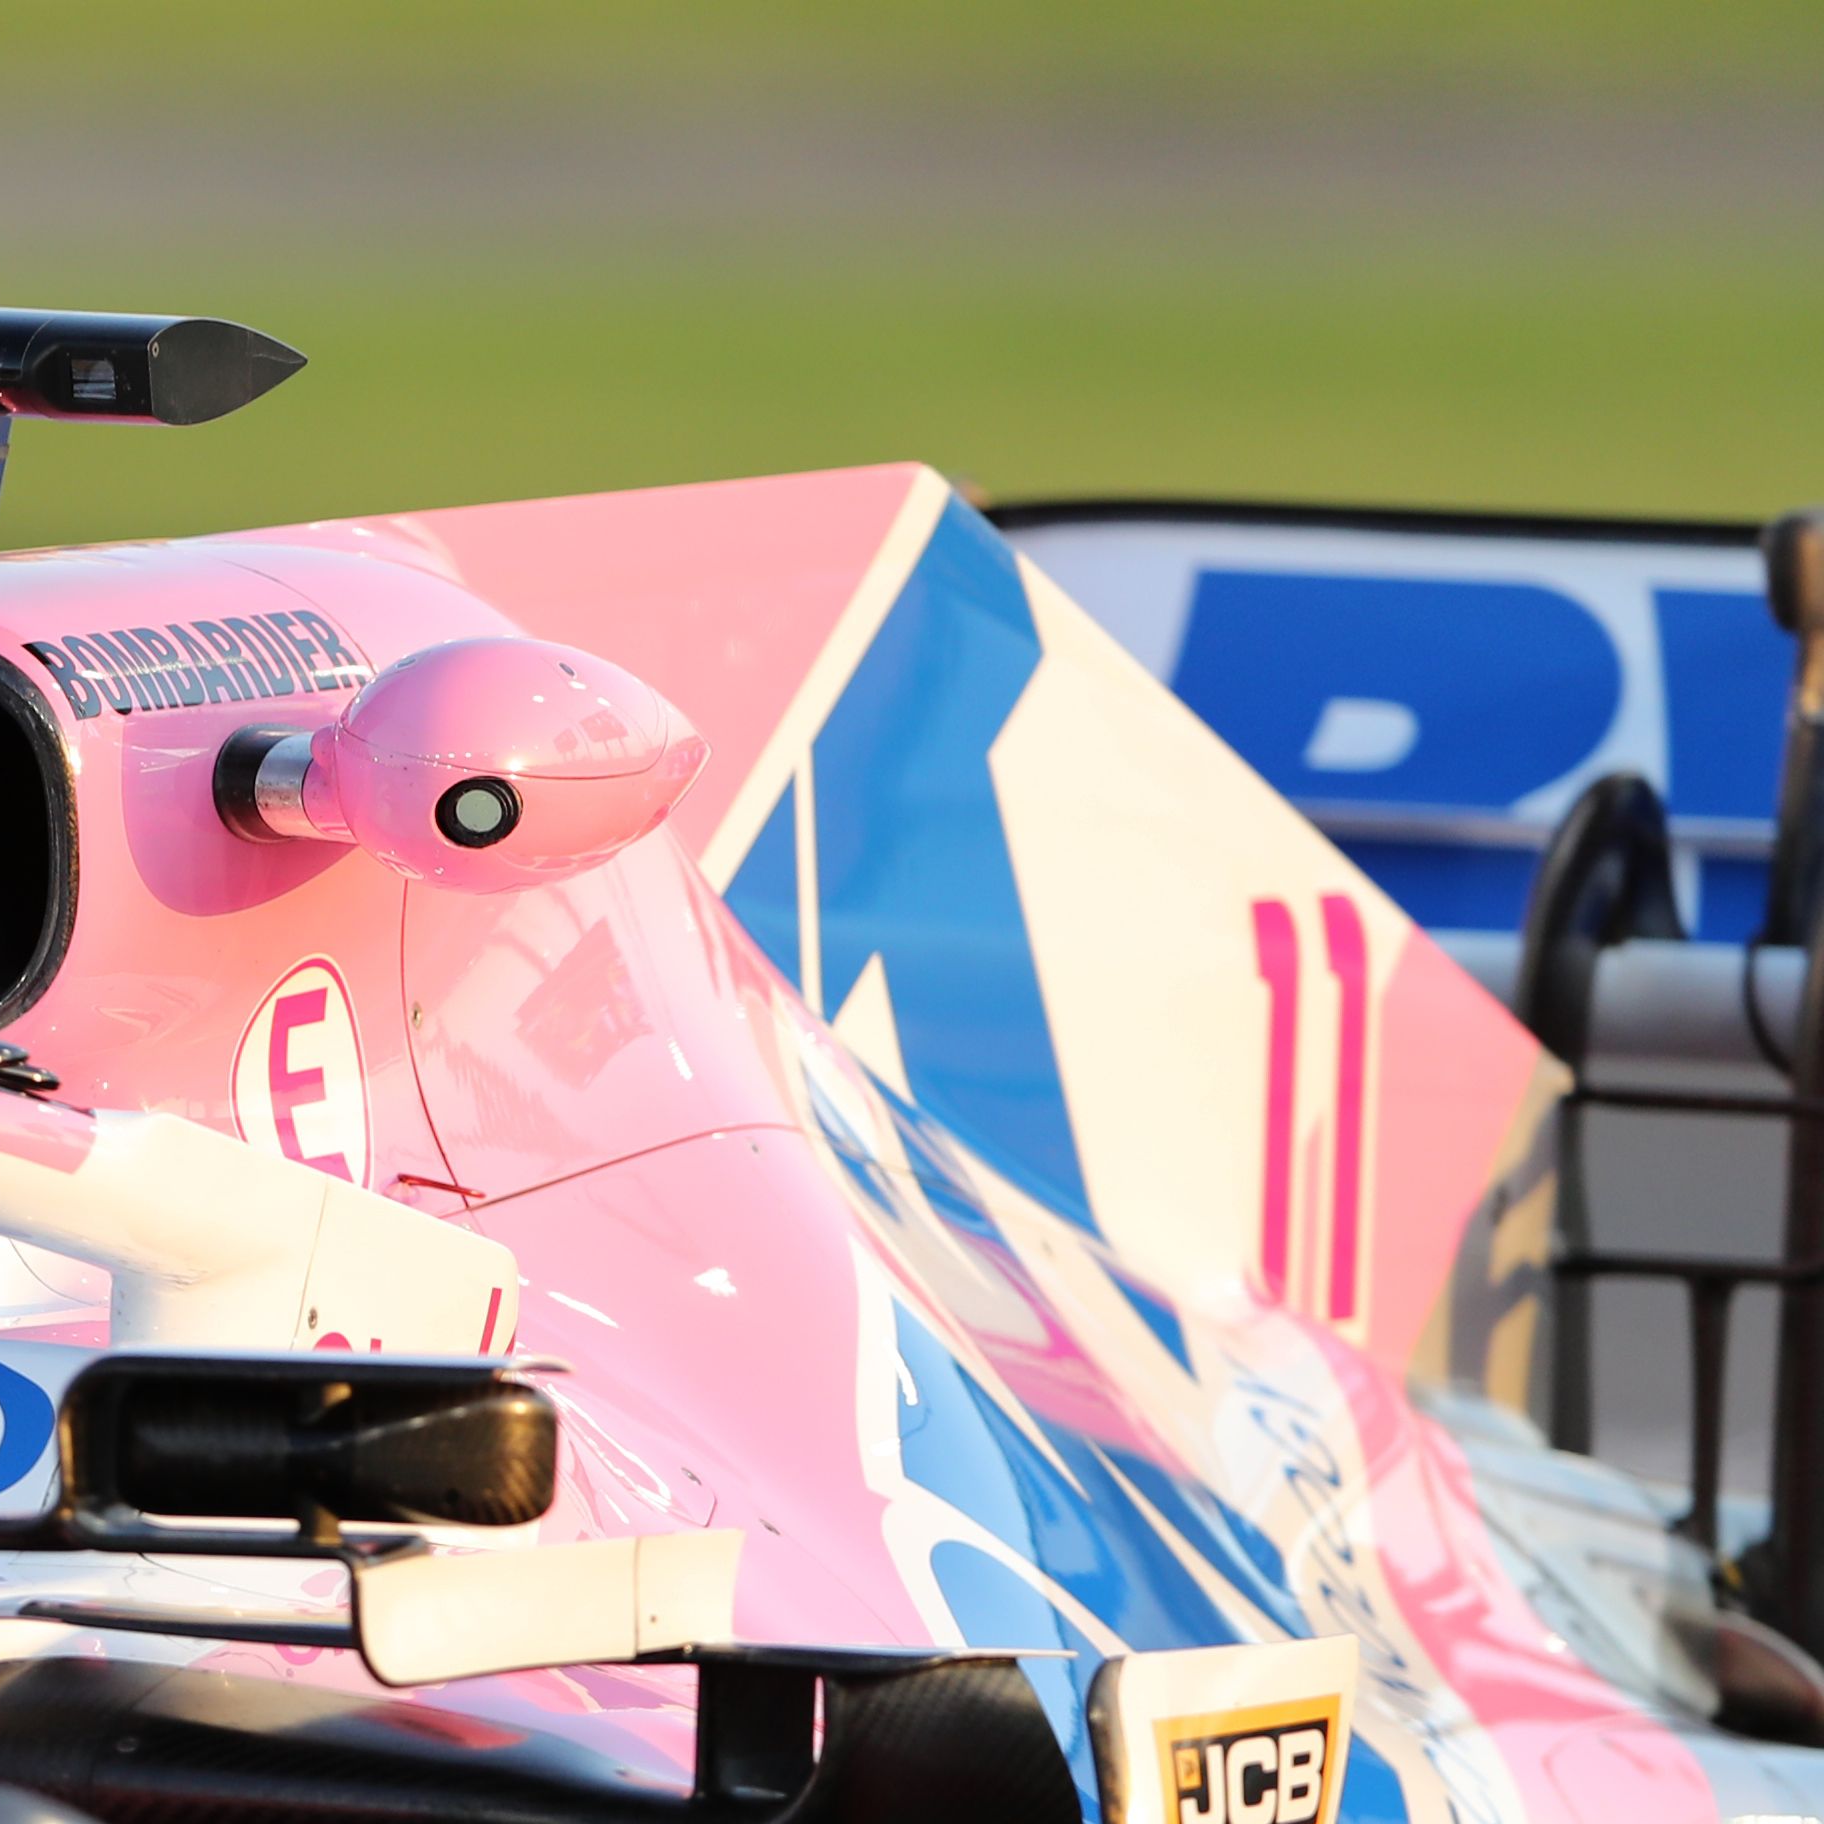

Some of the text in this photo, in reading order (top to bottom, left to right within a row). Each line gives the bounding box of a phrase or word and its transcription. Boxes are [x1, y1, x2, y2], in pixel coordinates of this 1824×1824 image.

[21, 609, 372, 720] BOMBARDIER
[268, 986, 354, 1181] E
[1251, 891, 1367, 1323] 11
